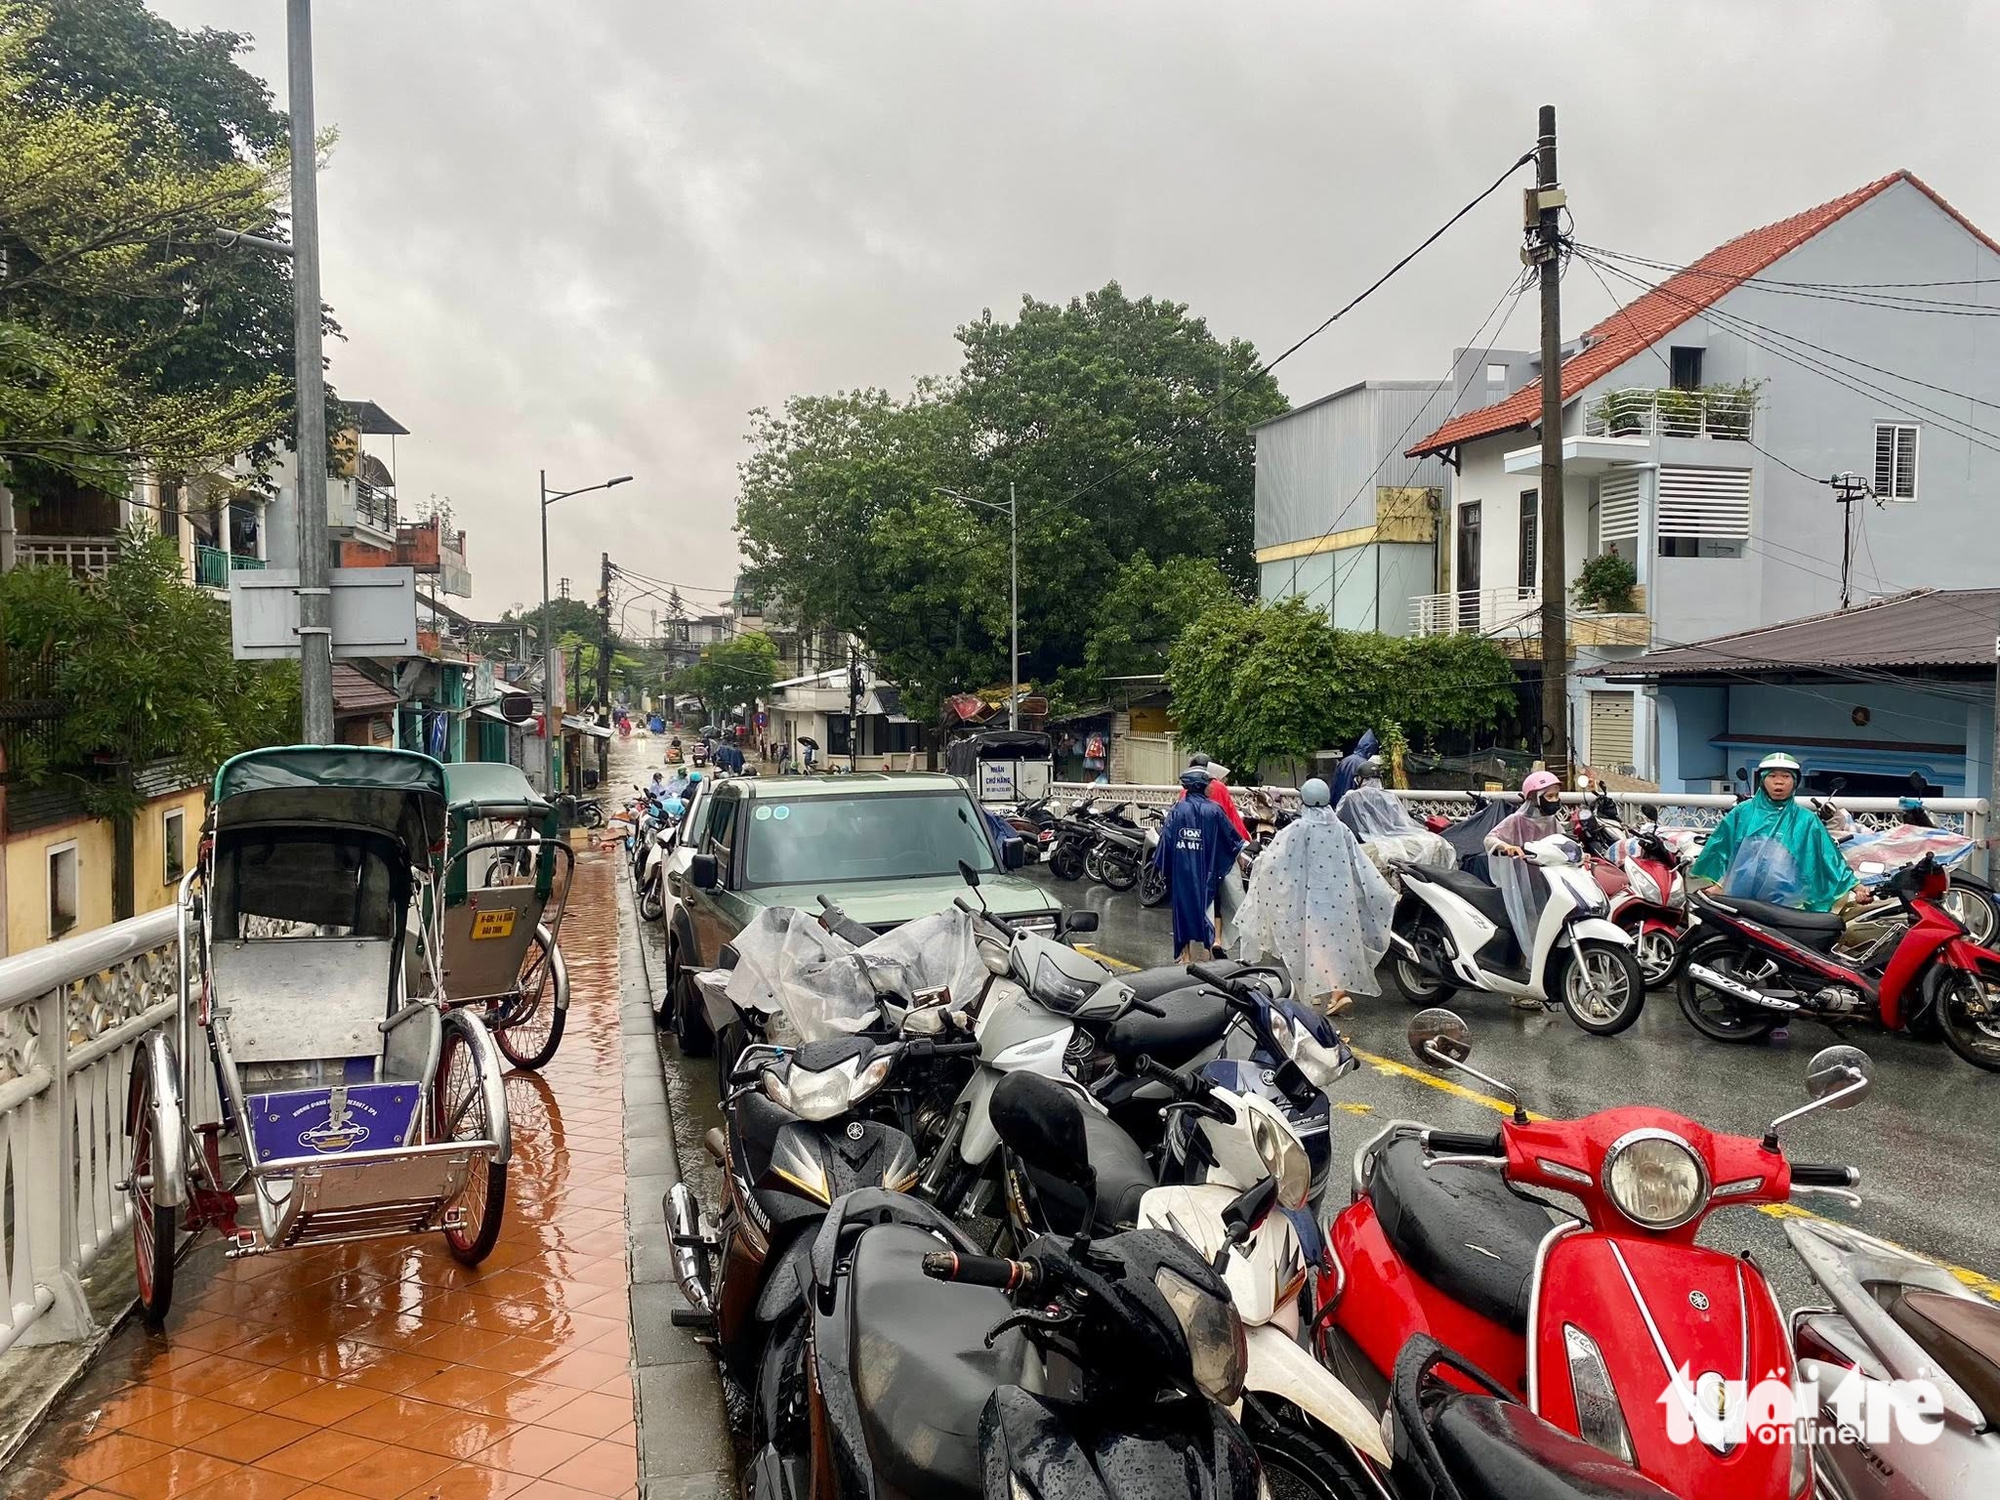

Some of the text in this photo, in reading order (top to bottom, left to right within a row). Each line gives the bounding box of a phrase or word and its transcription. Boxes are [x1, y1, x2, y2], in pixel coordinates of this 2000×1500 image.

[346, 1099, 366, 1109] RESORT
[367, 1107, 379, 1117] SPA
[747, 1192, 771, 1234] YAMAHA
